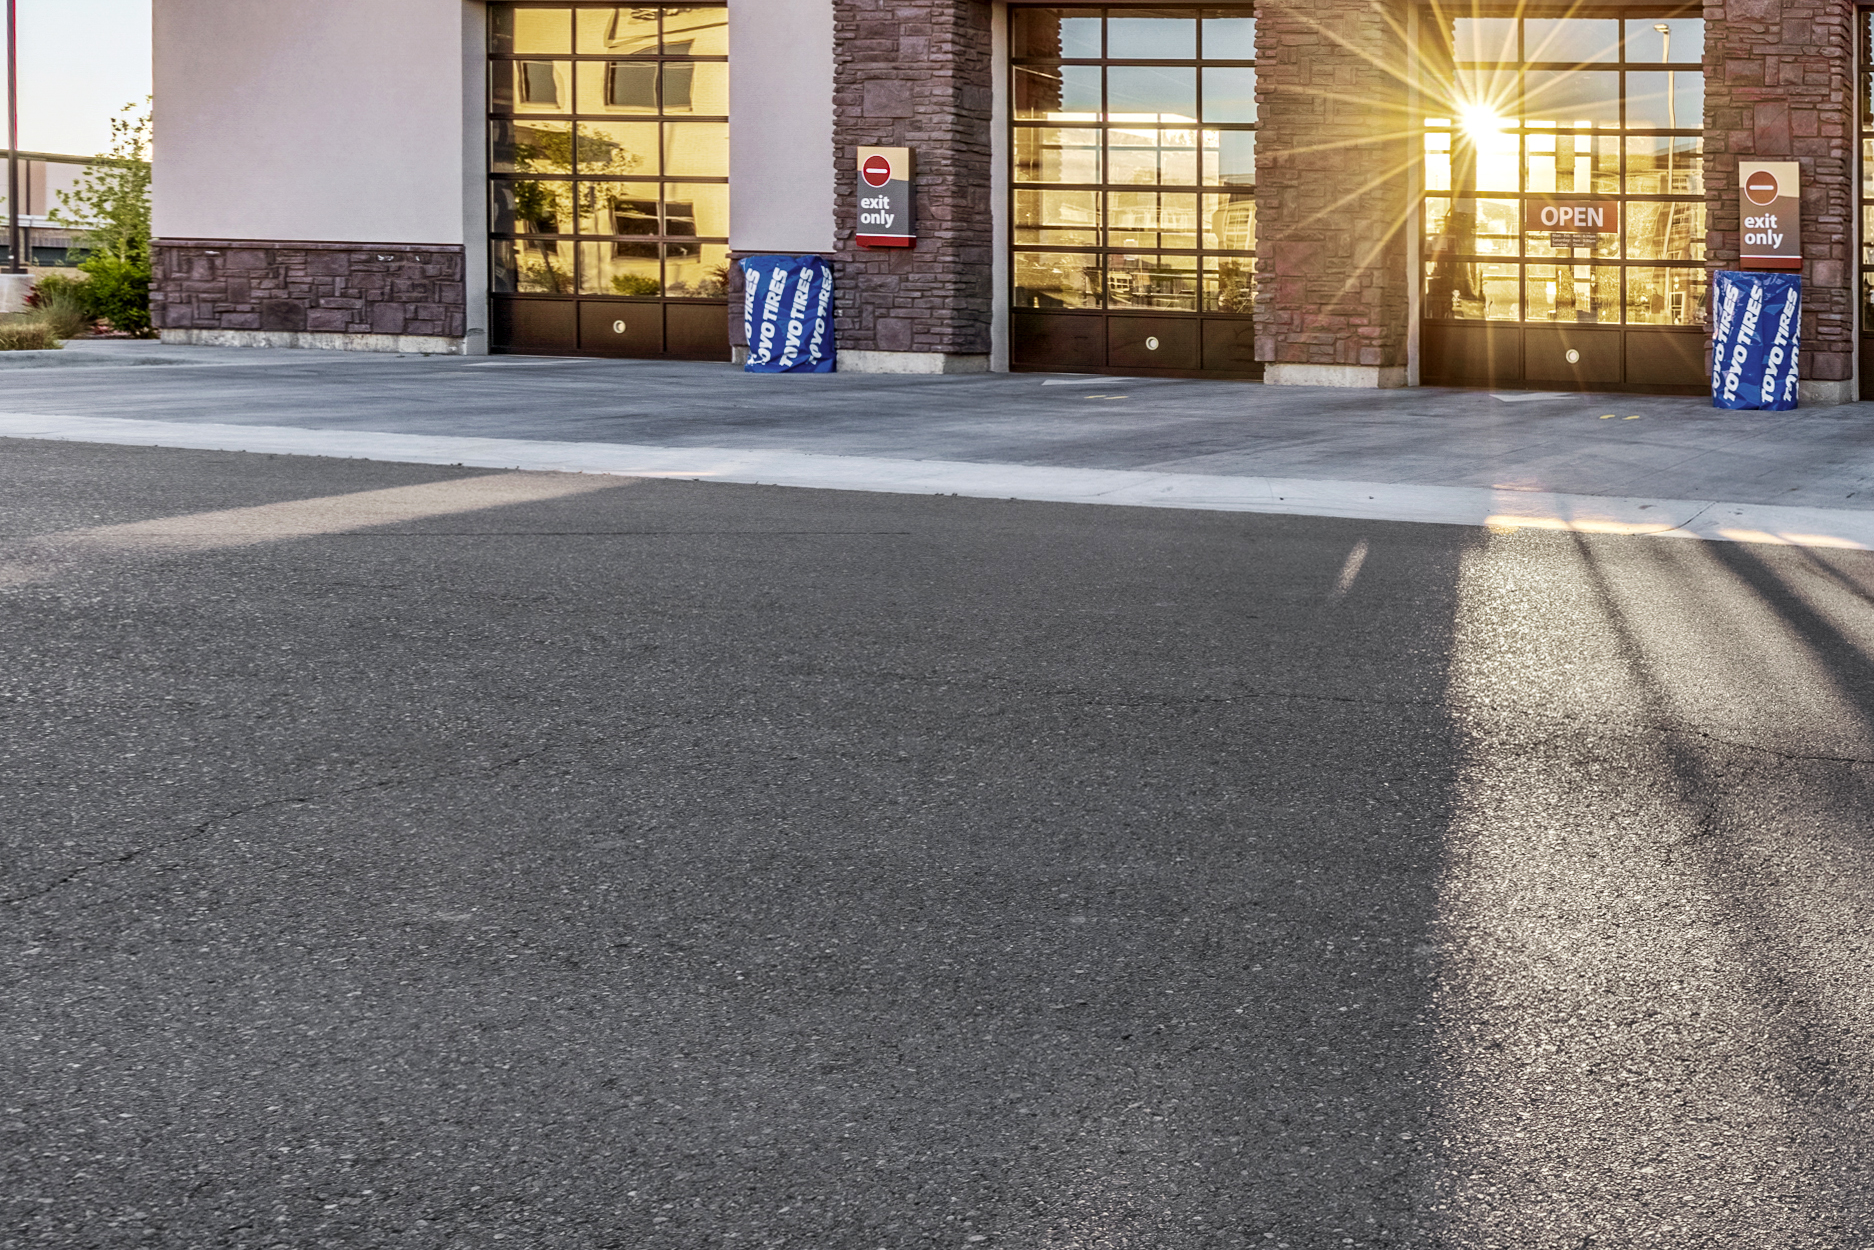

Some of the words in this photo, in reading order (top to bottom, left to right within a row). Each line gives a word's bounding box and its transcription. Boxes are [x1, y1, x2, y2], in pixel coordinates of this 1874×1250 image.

[860, 195, 890, 210] exit
[860, 210, 895, 228] only
[1540, 205, 1604, 227] OPEN
[1744, 213, 1778, 229] exit
[1744, 229, 1784, 249] only
[762, 266, 788, 321] TIRES
[790, 266, 814, 319] TIRES
[1718, 283, 1739, 343] TIRES
[779, 319, 803, 367] TOYO
[1723, 344, 1748, 402] TOYO
[1737, 284, 1763, 345] TIRES
[1761, 345, 1784, 403] TOYO
[1774, 287, 1798, 346] TIRES
